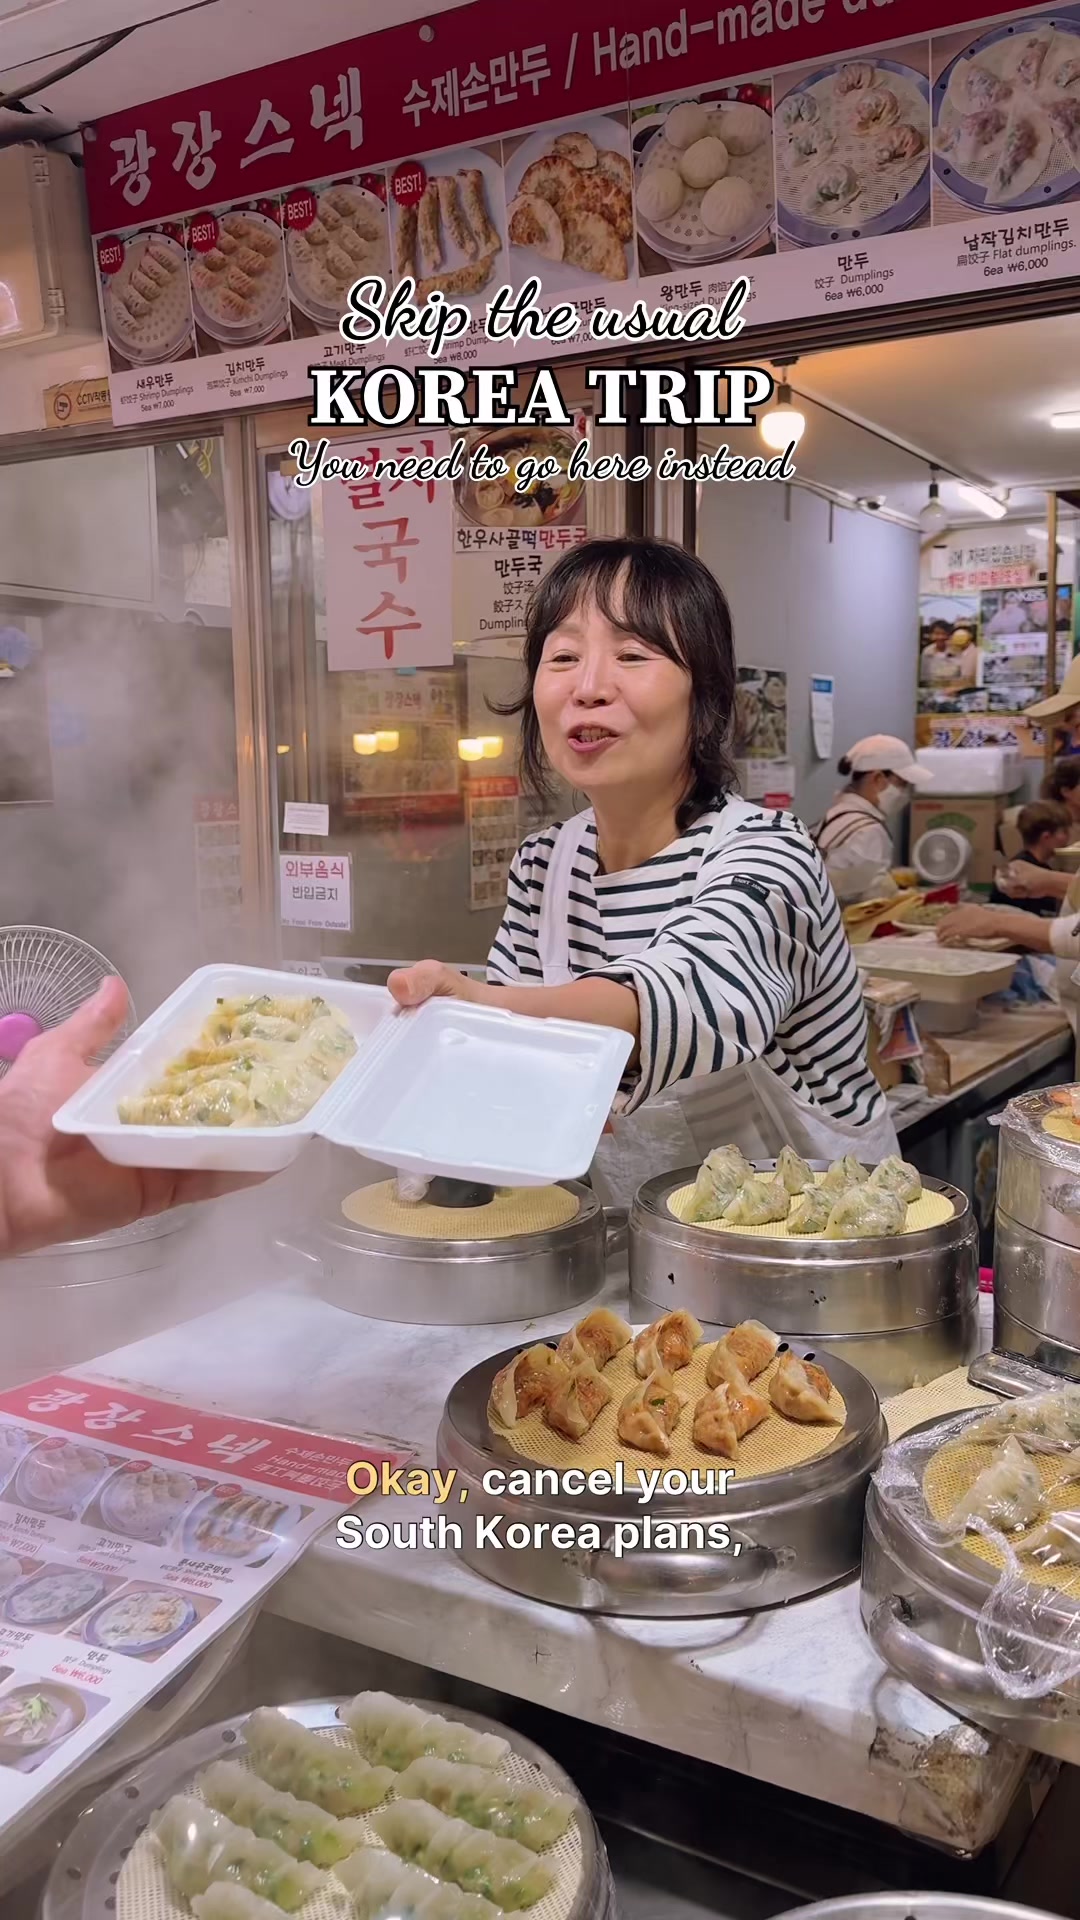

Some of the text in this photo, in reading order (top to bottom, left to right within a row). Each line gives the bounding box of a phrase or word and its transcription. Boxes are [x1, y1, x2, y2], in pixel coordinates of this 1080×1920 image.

[402, 44, 551, 127] 수제손만두
[395, 174, 423, 196] BEST!
[287, 200, 313, 221] BEST!
[191, 223, 216, 244] BEST!
[963, 218, 1070, 251] 납작김치만두
[100, 244, 122, 265] BEST!
[837, 252, 870, 272] 만두
[993, 246, 1013, 260] Flat
[814, 268, 894, 289] 饺子 Dumplings
[983, 266, 1004, 277] 6ea
[660, 280, 703, 302] 왕만두
[824, 291, 843, 302] 6ea
[324, 343, 367, 358] 고기만두
[348, 353, 385, 366] Dumplings
[225, 357, 266, 376] 김치만두
[136, 372, 174, 390] 새우만두
[232, 374, 254, 385] Kimchi
[254, 369, 288, 382] Dumplings
[139, 391, 160, 401] Shrimp
[161, 385, 194, 397] Dumplings
[494, 555, 543, 578] 만두국
[285, 860, 345, 879] 외부음식
[292, 886, 338, 901] 반입금지
